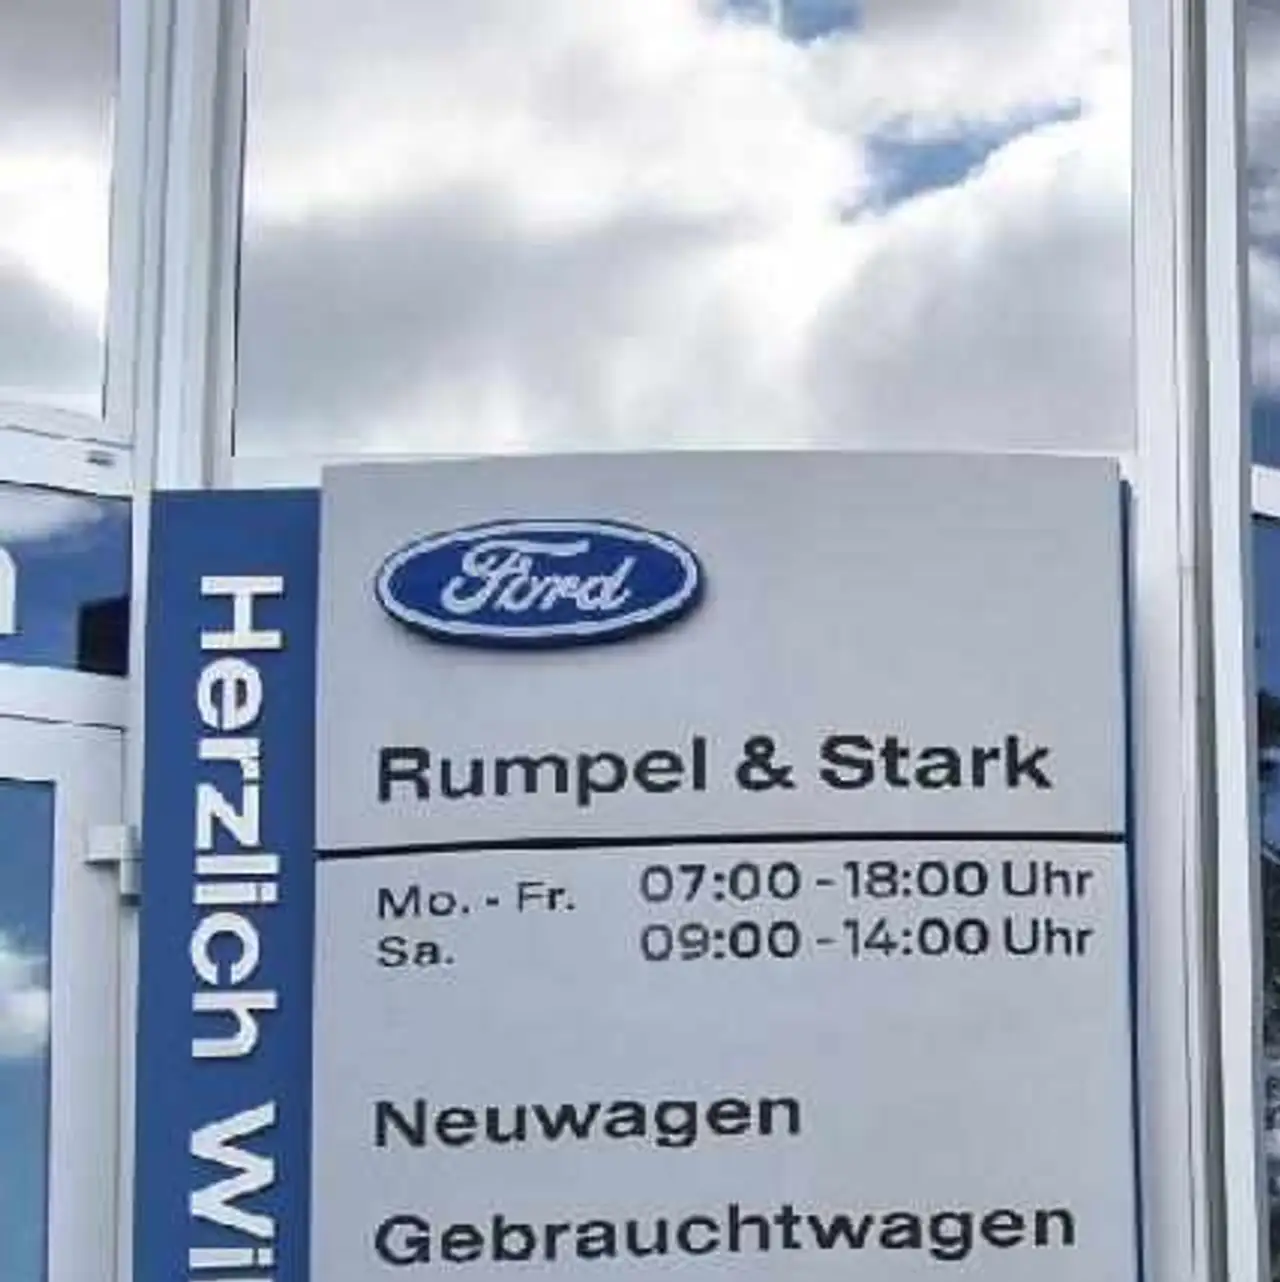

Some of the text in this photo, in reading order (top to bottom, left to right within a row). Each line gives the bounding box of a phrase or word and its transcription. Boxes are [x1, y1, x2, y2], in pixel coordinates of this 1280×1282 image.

[441, 539, 637, 614] Ford
[377, 734, 1053, 807] Rumpel & Stark
[189, 575, 285, 1058] Herzlich
[377, 884, 471, 921] Mo.
[515, 881, 577, 913] Fr.
[640, 860, 802, 903] 07:00
[1002, 860, 1094, 898] Uhr
[377, 935, 455, 969] Sa.
[640, 920, 802, 962] 09:00
[1002, 916, 1094, 957] Uhr
[375, 1096, 801, 1149] Neuwagen
[374, 1203, 1076, 1267] Gebrauchtwagen
